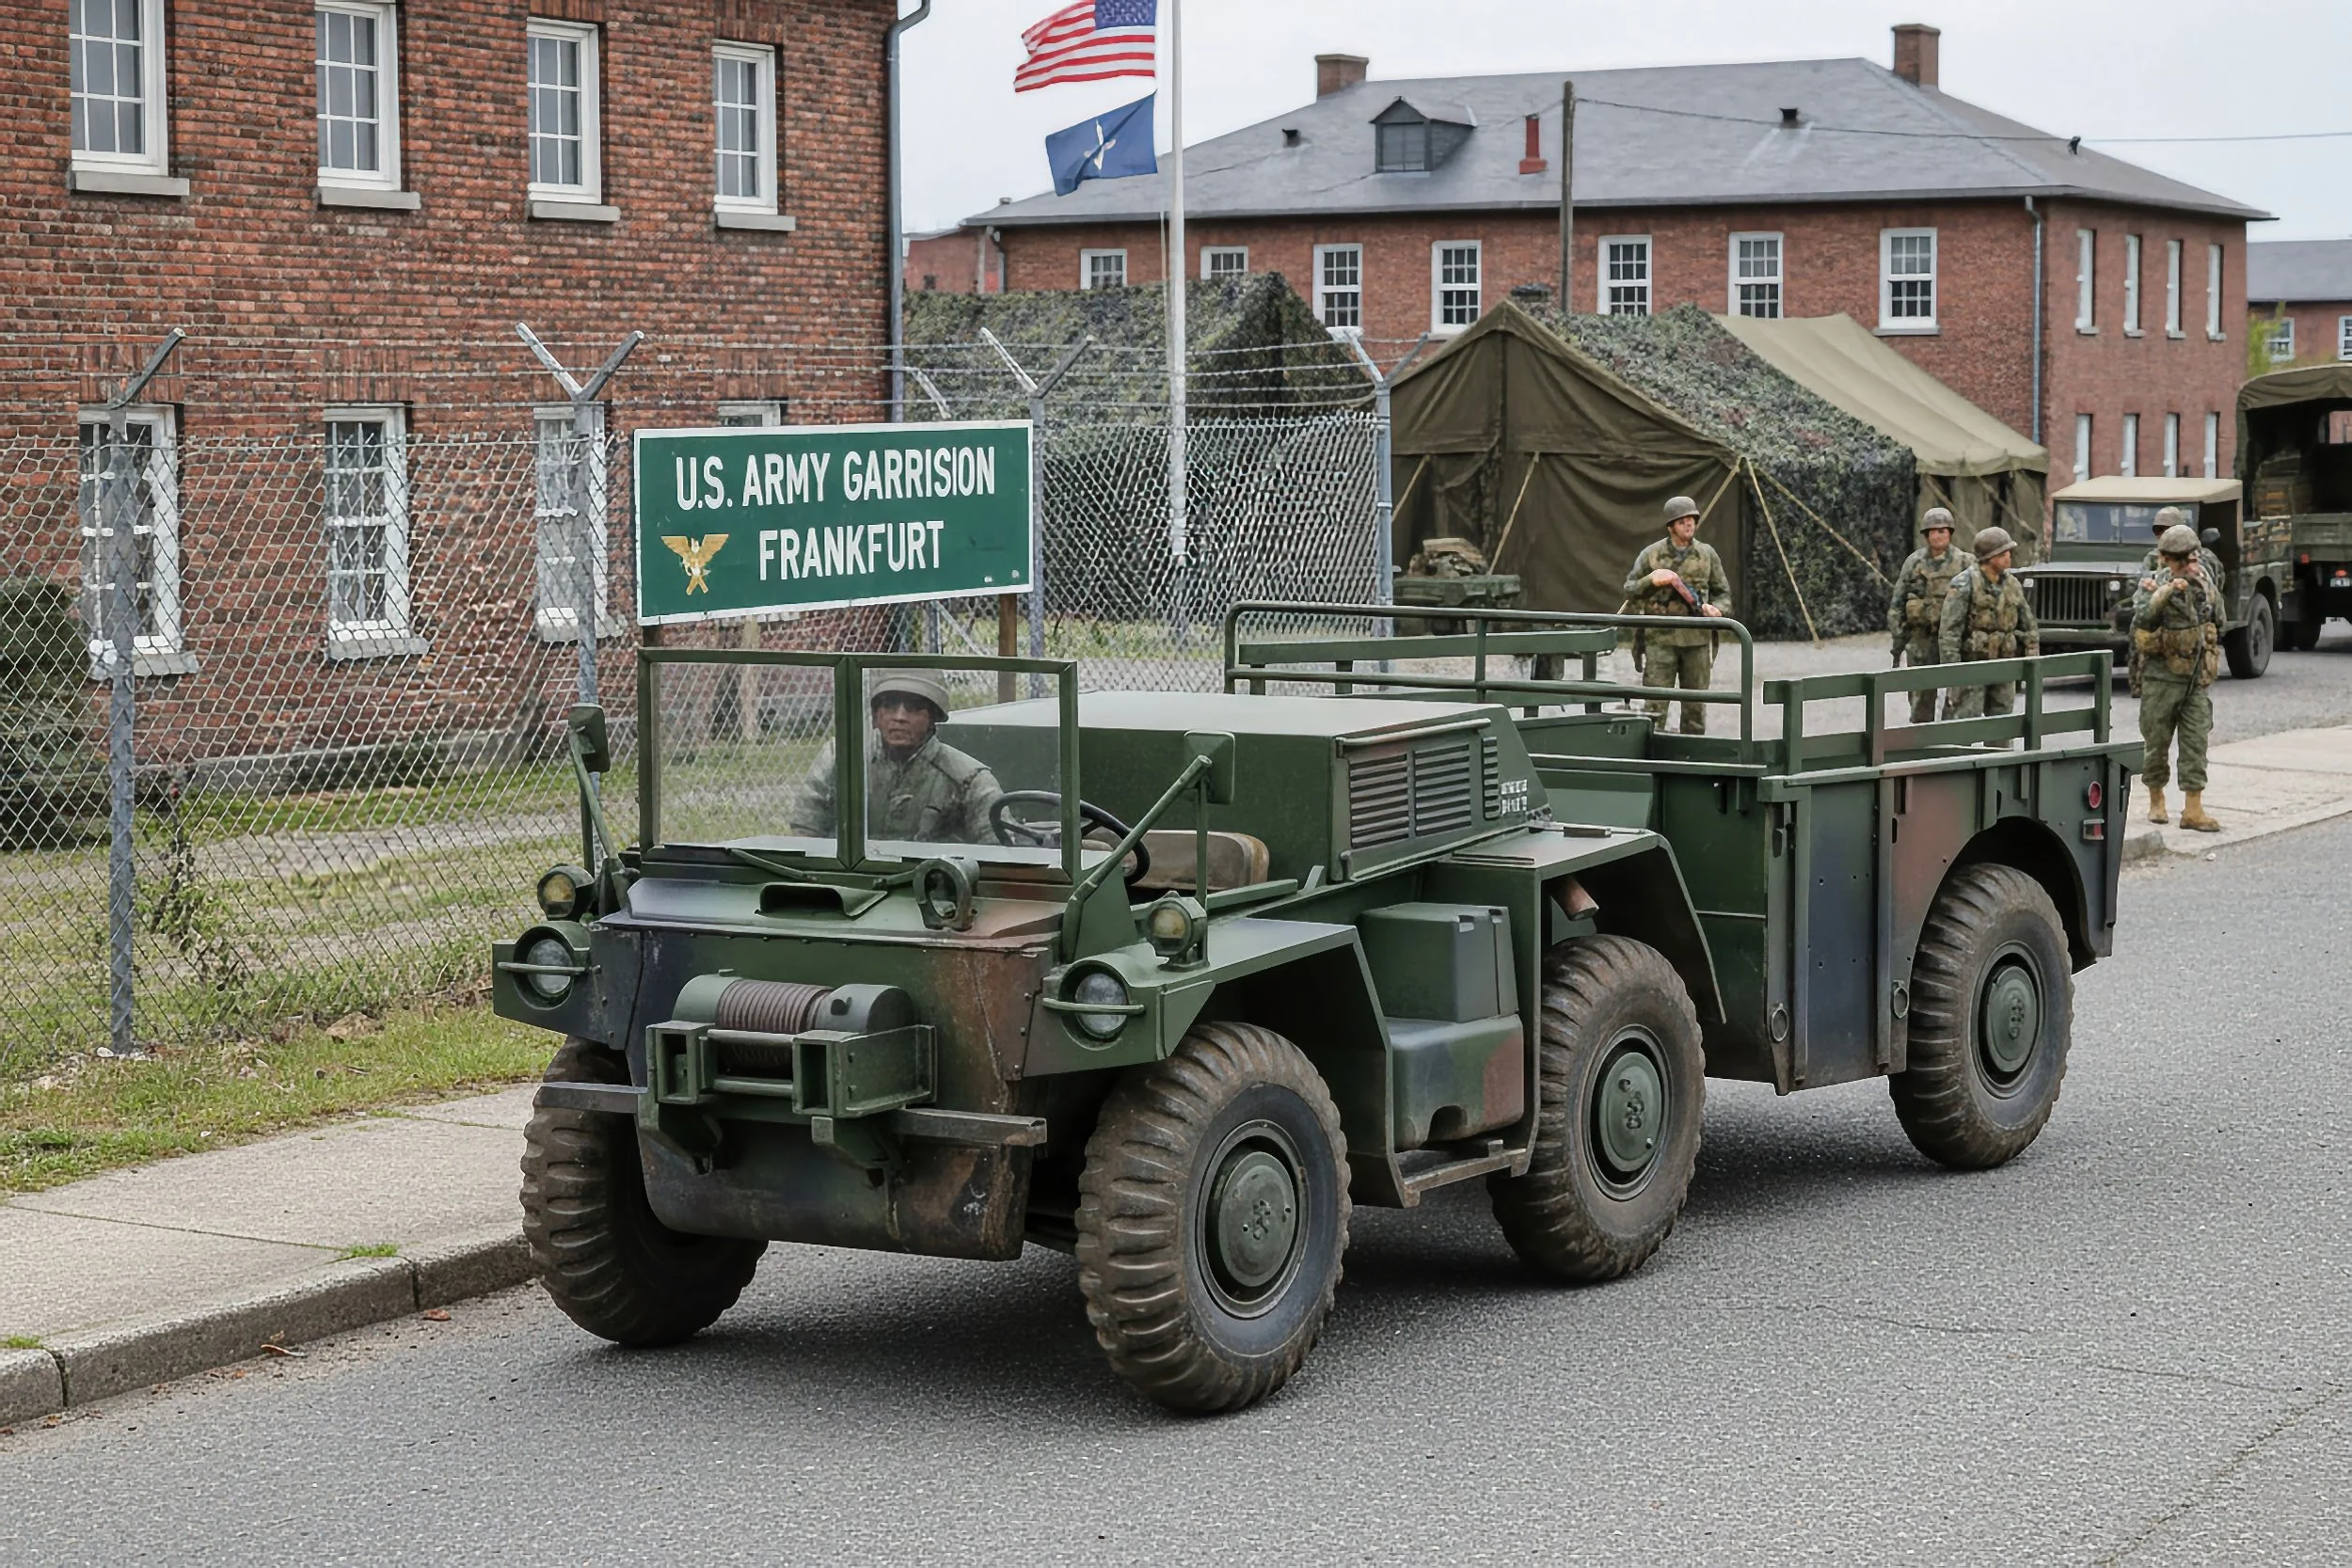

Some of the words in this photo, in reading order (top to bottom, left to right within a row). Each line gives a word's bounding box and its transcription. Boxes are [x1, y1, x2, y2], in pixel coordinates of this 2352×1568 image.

[675, 455, 733, 511] U.S.
[741, 452, 832, 507] ARMY
[843, 446, 995, 501] GARRISION
[758, 519, 945, 581] FRANKFURT
